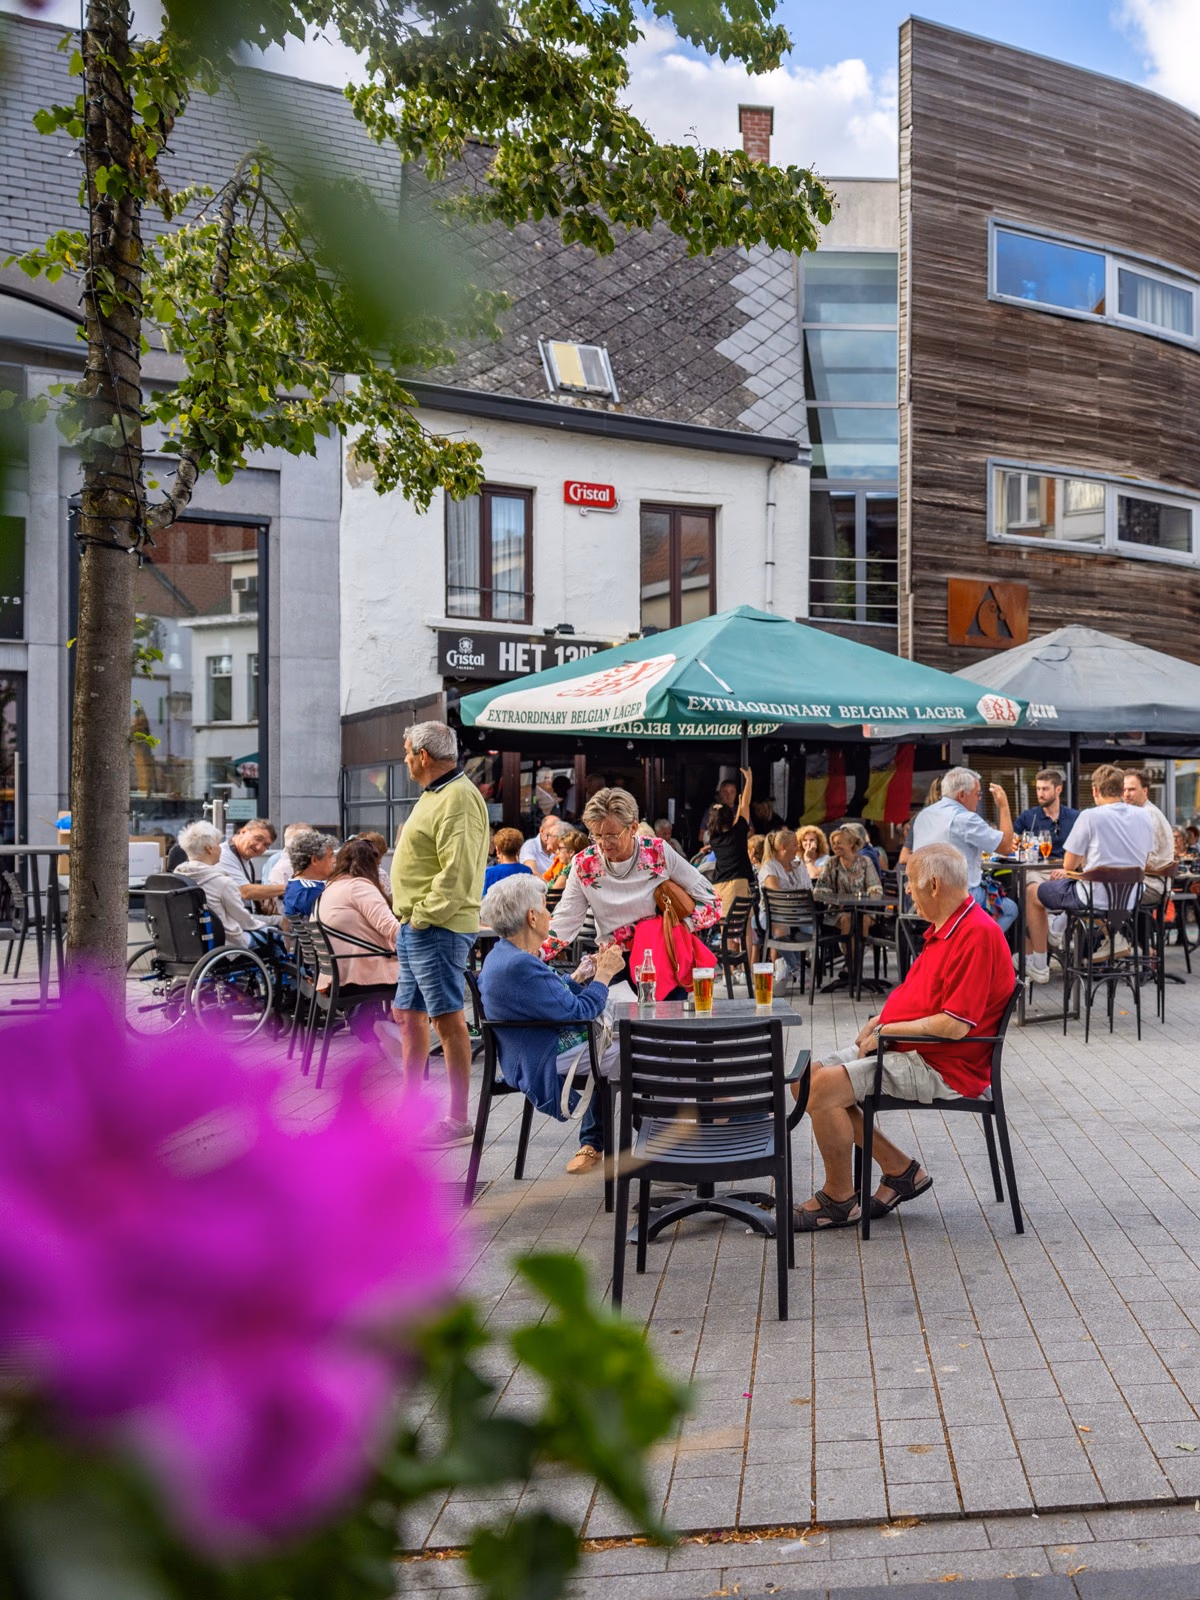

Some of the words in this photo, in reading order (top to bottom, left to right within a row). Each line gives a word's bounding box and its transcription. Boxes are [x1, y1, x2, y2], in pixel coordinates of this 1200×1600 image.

[569, 483, 610, 502] Cristal
[446, 649, 485, 667] Cristal
[499, 641, 547, 672] HET
[487, 708, 567, 725] EXTRAORDINARY
[571, 707, 610, 724] BELGIAN
[613, 701, 642, 720] LAGER
[687, 696, 832, 718] EXTRAORDINARY
[839, 705, 909, 719] BELGIAN
[914, 706, 967, 720] LAGER
